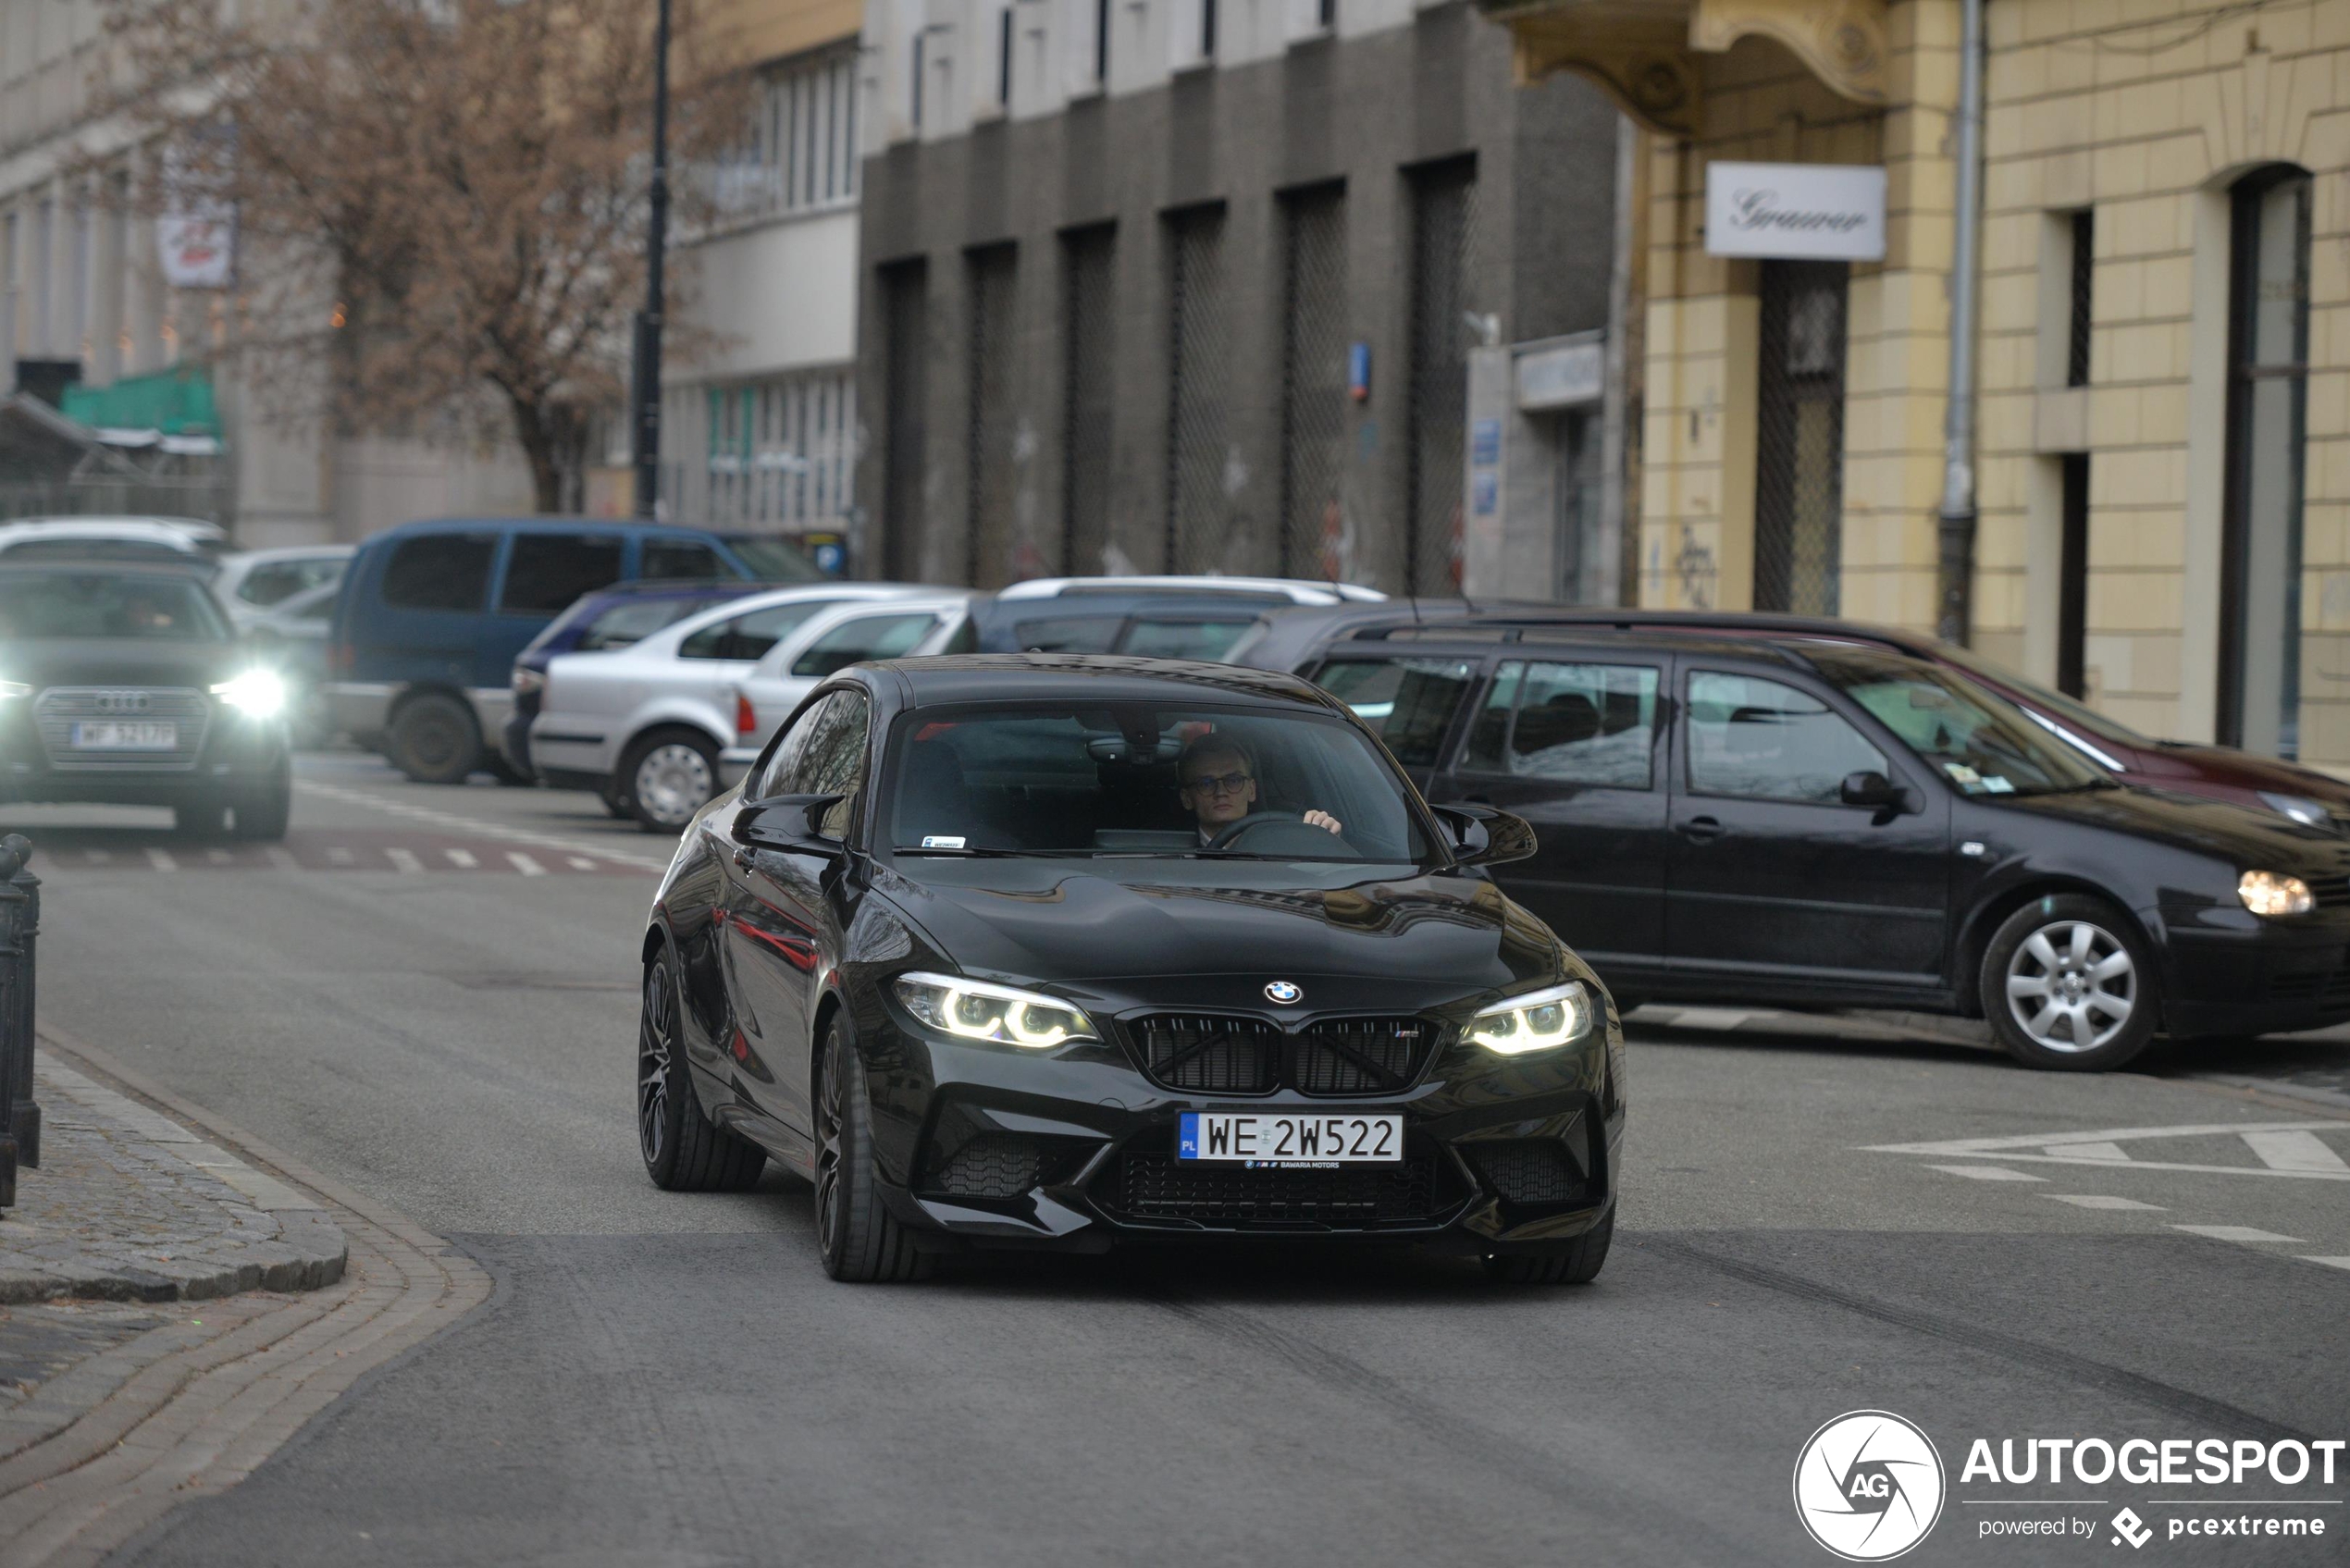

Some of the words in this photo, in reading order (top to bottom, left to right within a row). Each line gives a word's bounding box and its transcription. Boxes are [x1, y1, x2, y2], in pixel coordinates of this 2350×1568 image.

[1181, 1141, 1195, 1151] PL
[1208, 1117, 1257, 1155] WE
[1273, 1118, 1393, 1156] 2W522
